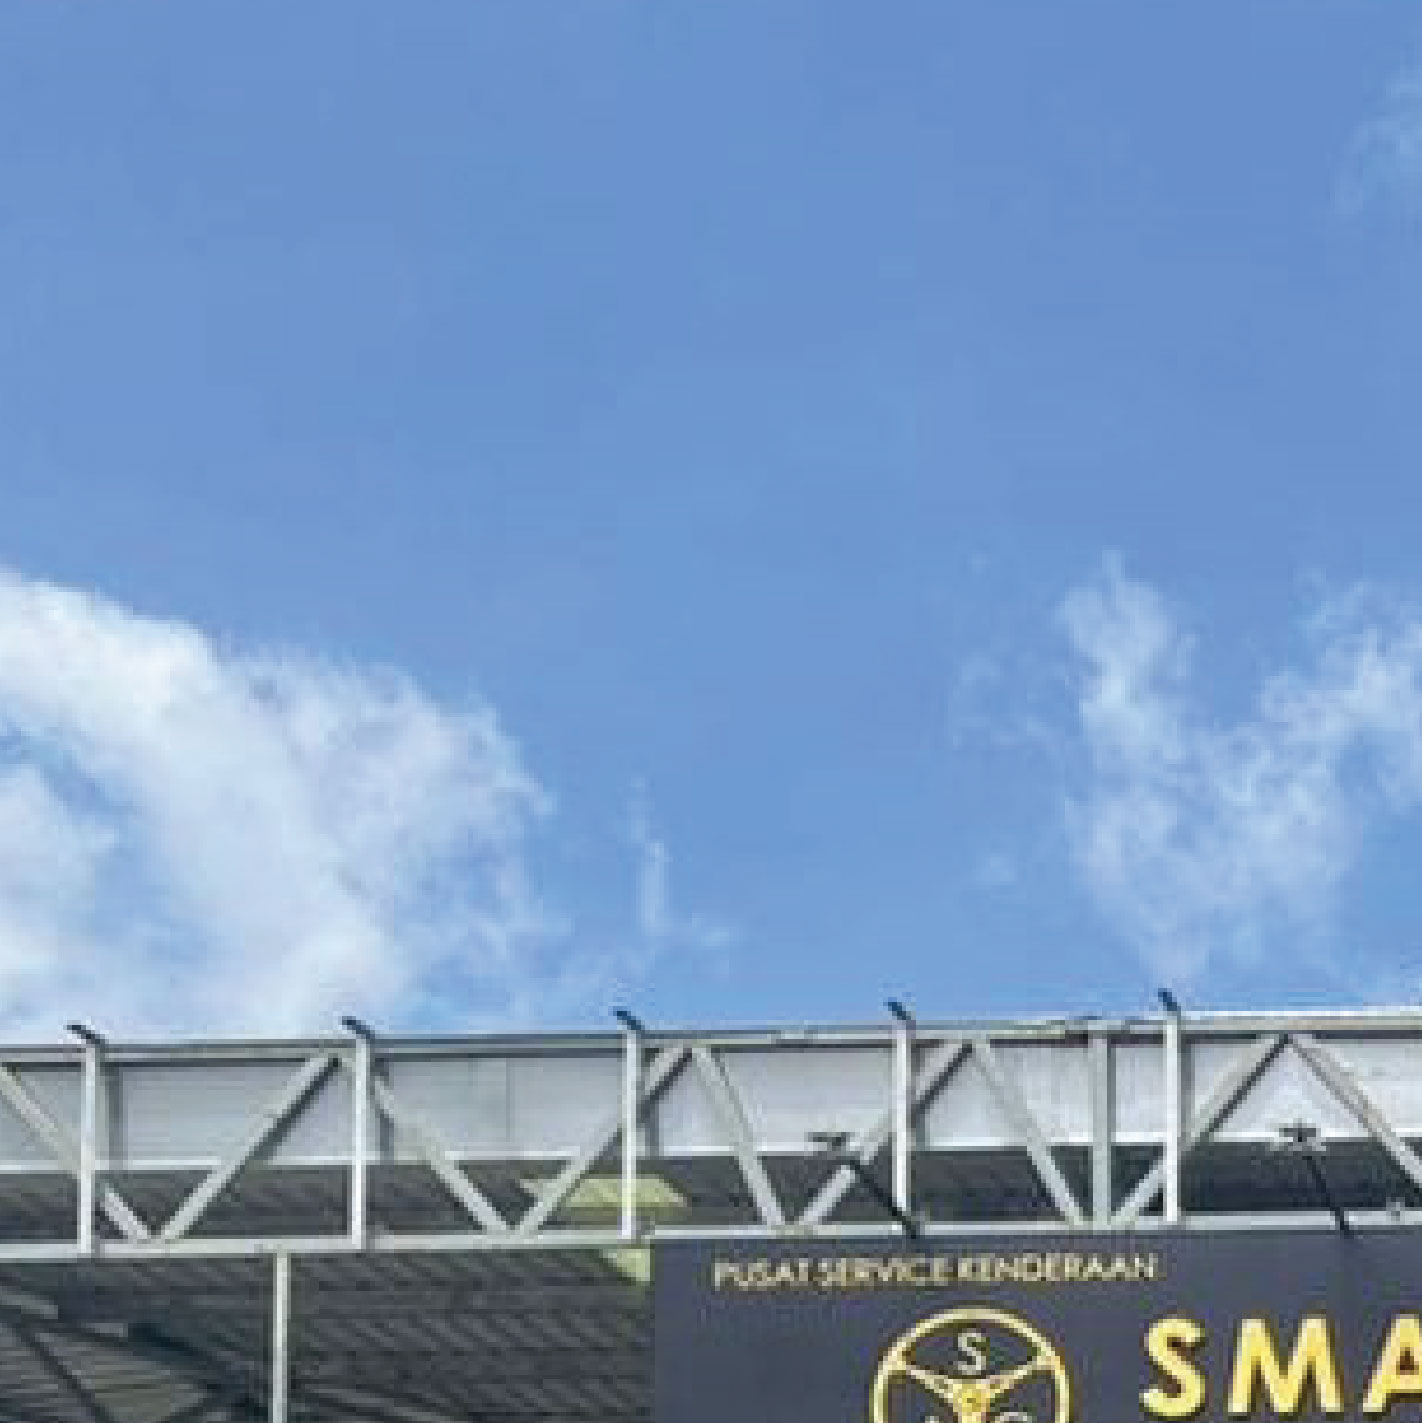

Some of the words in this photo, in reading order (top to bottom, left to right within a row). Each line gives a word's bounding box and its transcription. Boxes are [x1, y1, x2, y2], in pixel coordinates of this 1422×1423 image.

[714, 1257, 809, 1291] PUSAT
[817, 1255, 949, 1288] SERVICE
[957, 1252, 1157, 1282] KENDERAAN
[957, 1331, 987, 1376] S
